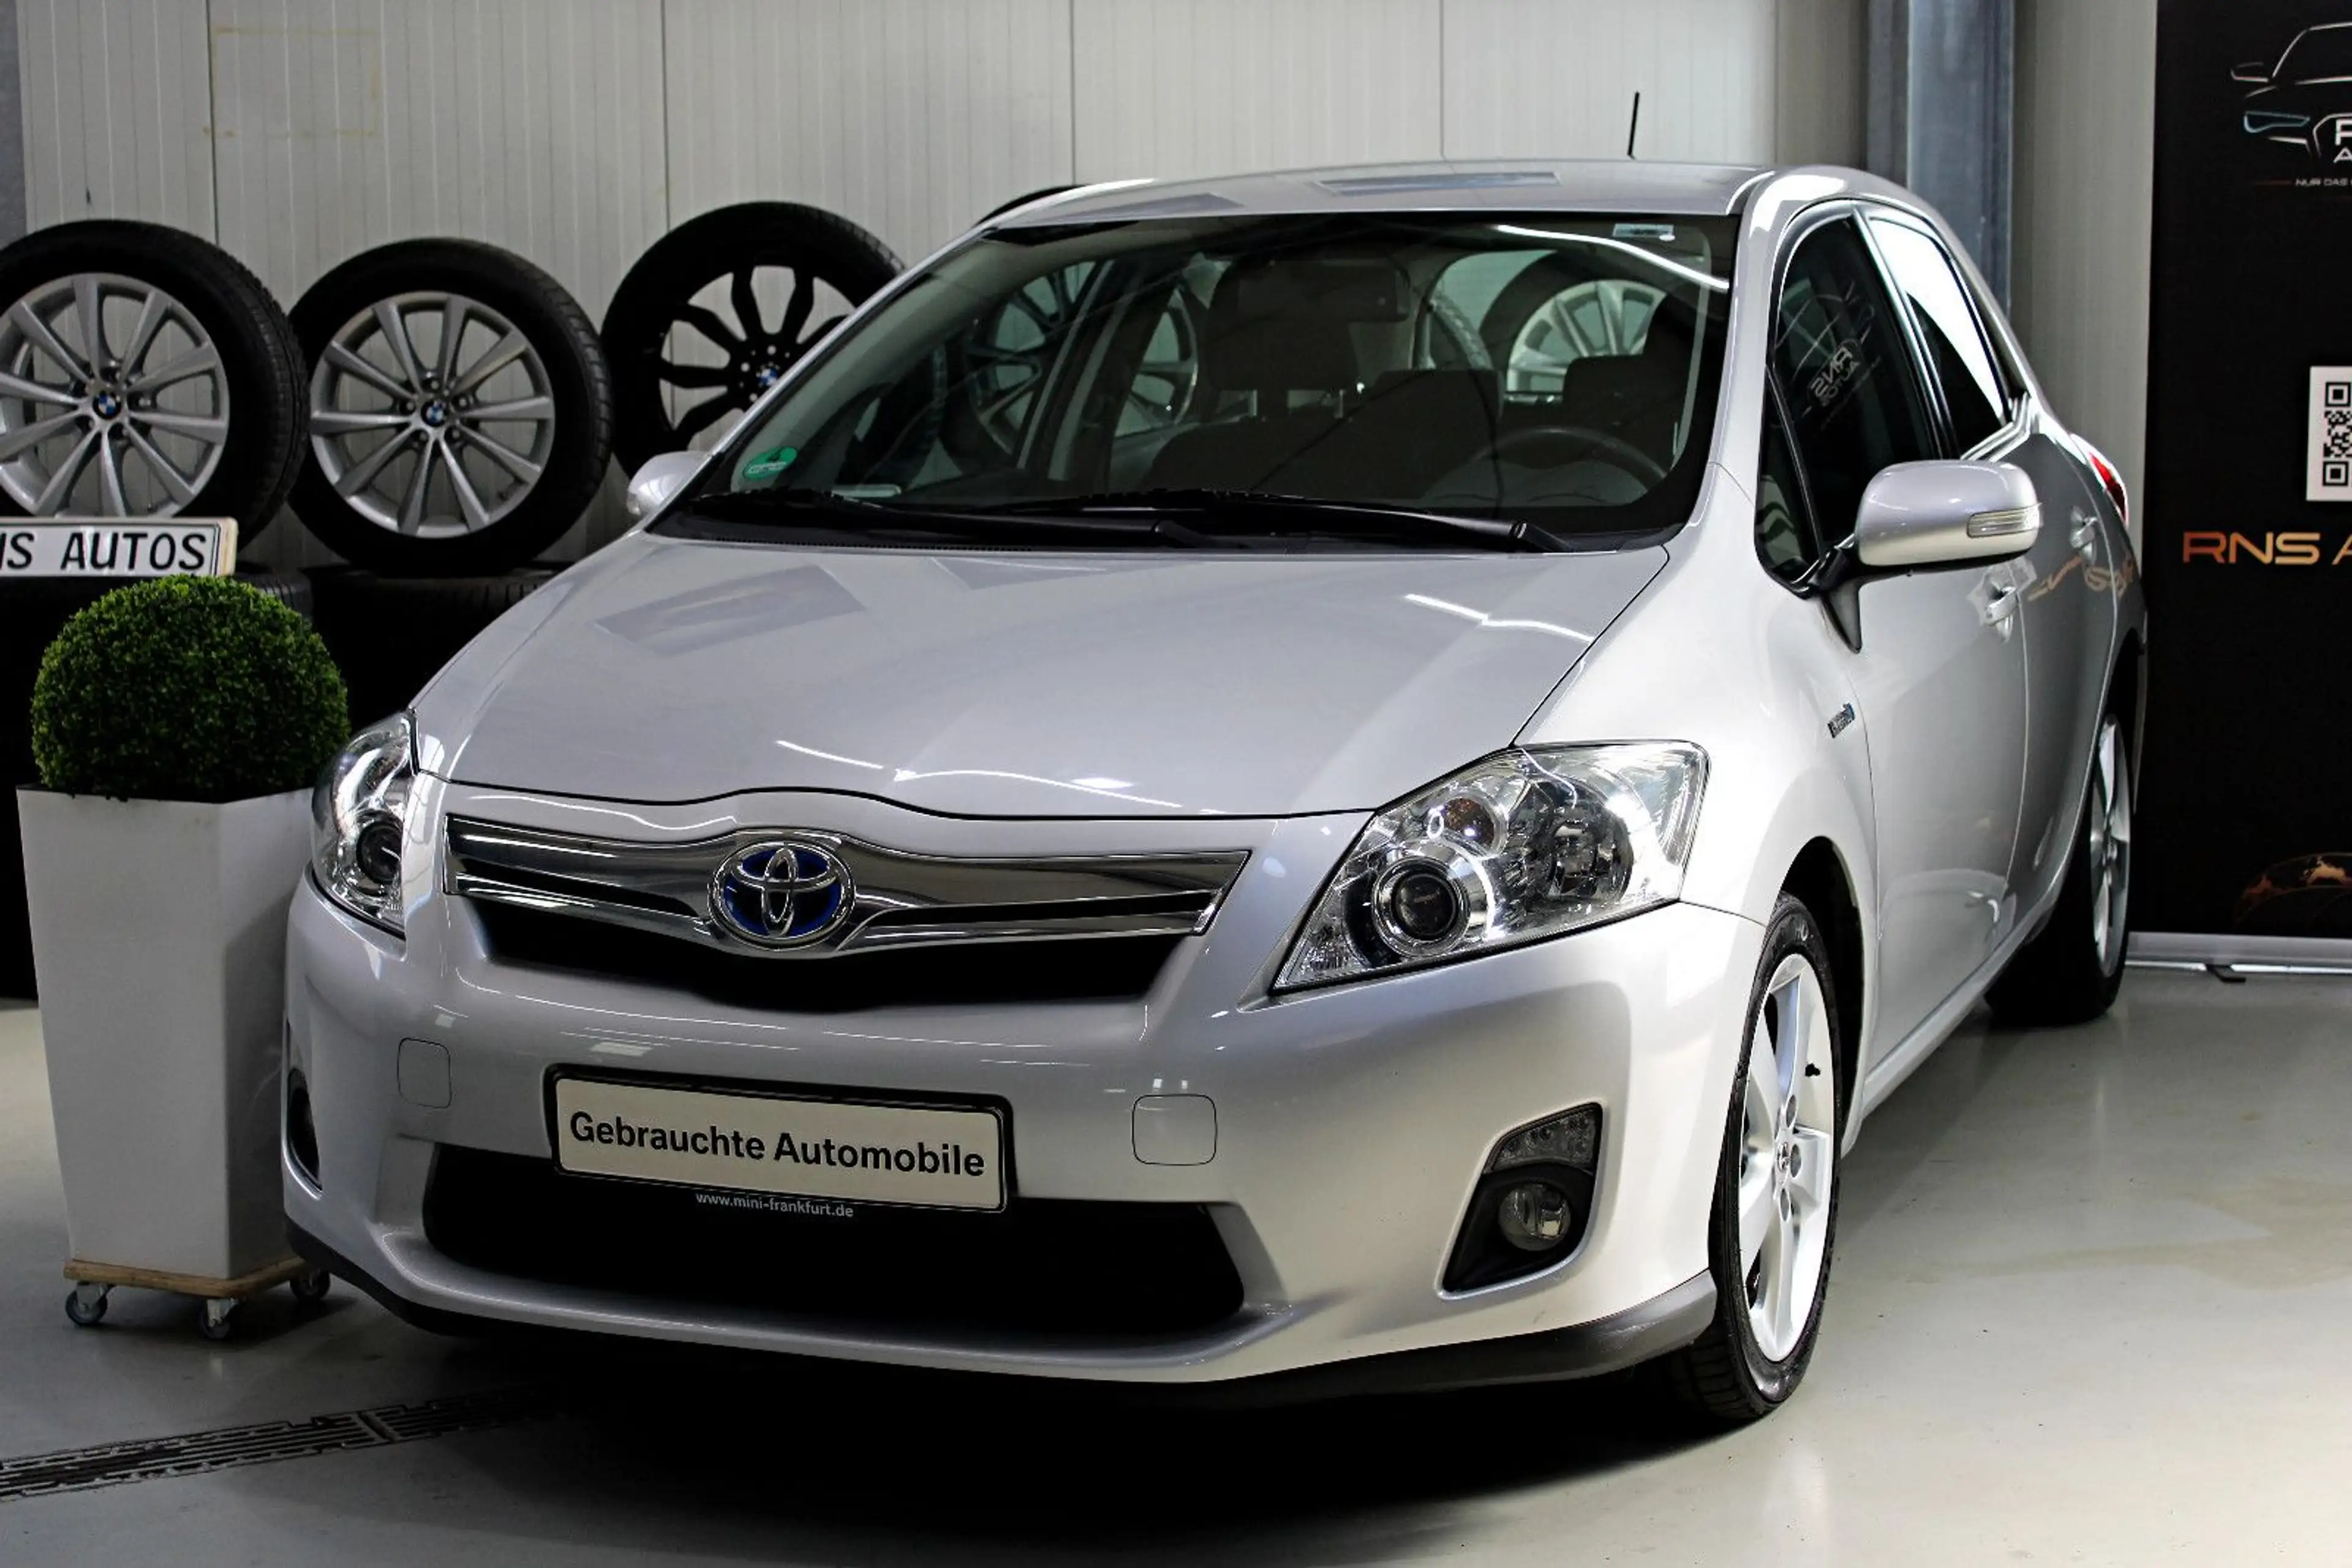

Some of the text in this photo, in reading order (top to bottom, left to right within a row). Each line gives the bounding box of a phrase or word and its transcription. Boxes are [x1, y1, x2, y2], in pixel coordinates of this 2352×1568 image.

[61, 532, 207, 571] AUTOS
[2183, 532, 2320, 565] RNS
[570, 1111, 985, 1177] Gebrauchte Automobile
[695, 1193, 854, 1218] www.mini-frankfurt.de
